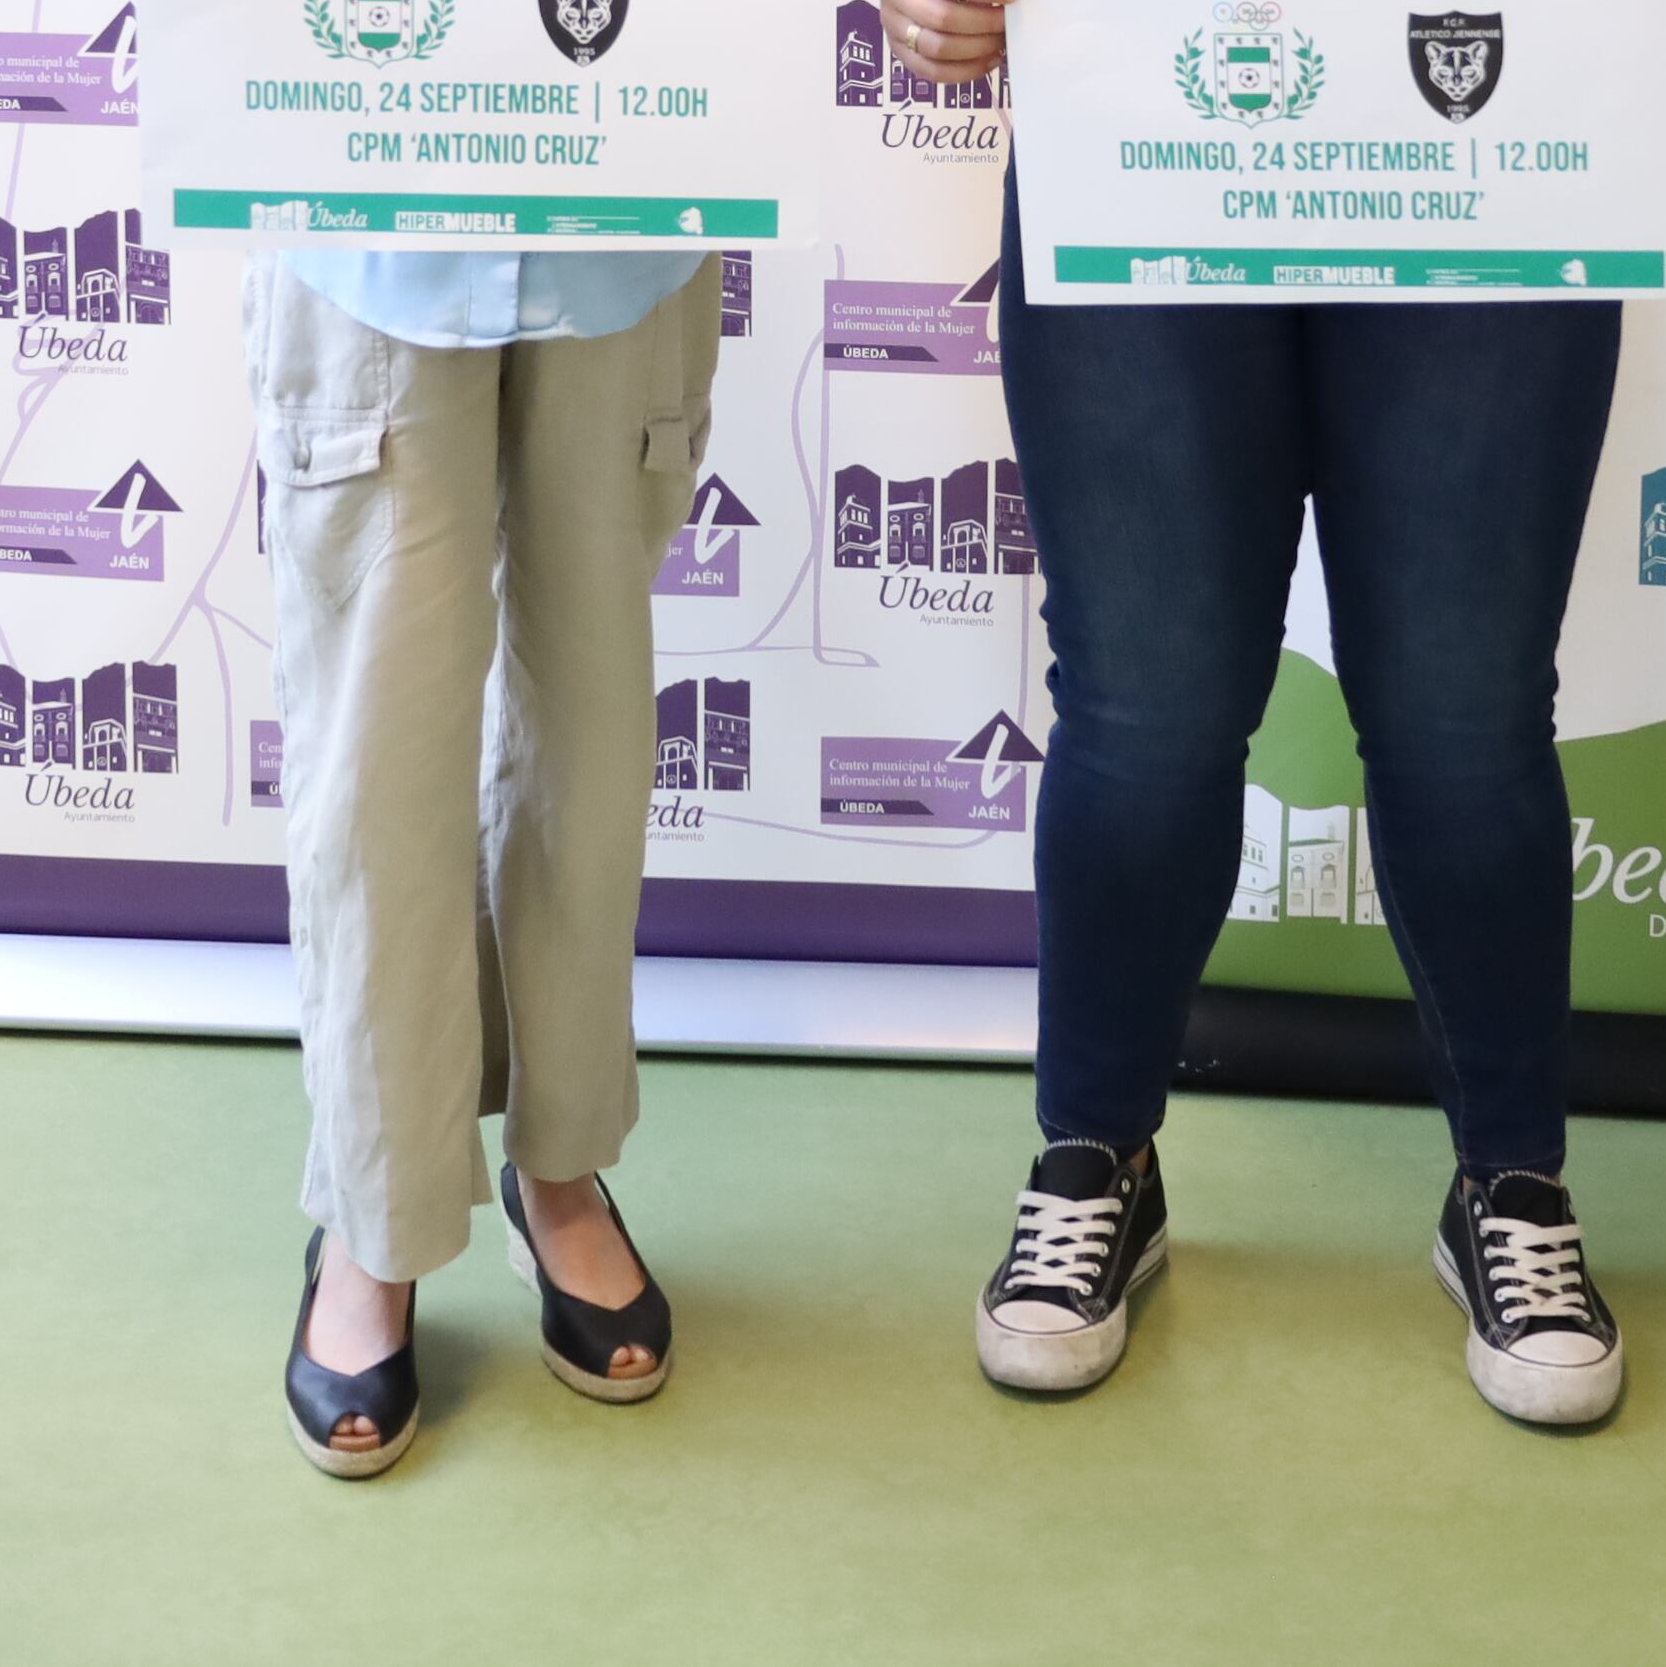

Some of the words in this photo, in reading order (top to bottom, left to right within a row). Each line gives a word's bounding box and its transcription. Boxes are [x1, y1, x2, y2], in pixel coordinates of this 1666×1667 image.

[7, 56, 62, 70] municipal
[65, 57, 79, 68] de
[37, 72, 50, 83] de
[54, 72, 64, 83] la
[67, 73, 101, 86] Mujer
[246, 79, 372, 118] DOMINGO,
[380, 83, 412, 114] 24
[420, 83, 579, 115] SEPTIEMBRE
[617, 86, 708, 118] 12.00H
[882, 99, 999, 149] Úbeda
[347, 132, 402, 162] CPM
[923, 153, 999, 165] Ayuntamiento
[1121, 141, 1244, 176] DOMINGO,
[1253, 141, 1285, 171] 24
[1293, 141, 1454, 171] SEPTIEMBRE
[1495, 141, 1589, 171] 12.00H
[1223, 191, 1277, 220] CPM
[308, 201, 368, 228] Úbeda
[1186, 255, 1246, 282] Úbeda
[833, 303, 873, 315] Centro
[876, 304, 934, 319] municipal
[937, 306, 951, 318] de
[833, 319, 903, 332] información
[907, 320, 921, 332] de
[925, 321, 935, 333] la
[939, 322, 975, 336] Mujer
[19, 313, 128, 362] Úbeda
[843, 345, 889, 359] ÚBEDA
[973, 348, 1001, 364] JAÉ
[19, 508, 73, 523] municipal
[76, 511, 89, 522] de
[48, 525, 62, 536] de
[65, 525, 75, 537] la
[78, 527, 111, 541] Mujer
[109, 553, 150, 569] JAÉN
[681, 569, 724, 584] JAÉN
[879, 562, 994, 613] Úbeda
[920, 614, 994, 627] Ayuntamiento
[829, 758, 869, 771] Centro
[872, 760, 930, 773] municipal
[933, 761, 947, 773] de
[25, 761, 135, 810] Úbeda
[829, 775, 900, 787] información
[903, 775, 918, 787] de
[921, 776, 931, 787] la
[934, 777, 971, 791] Mujer
[645, 795, 704, 828] eda
[840, 800, 885, 814] ÚBEDA
[968, 803, 1010, 820] JAÉN
[64, 812, 135, 823] Ayuntamiento
